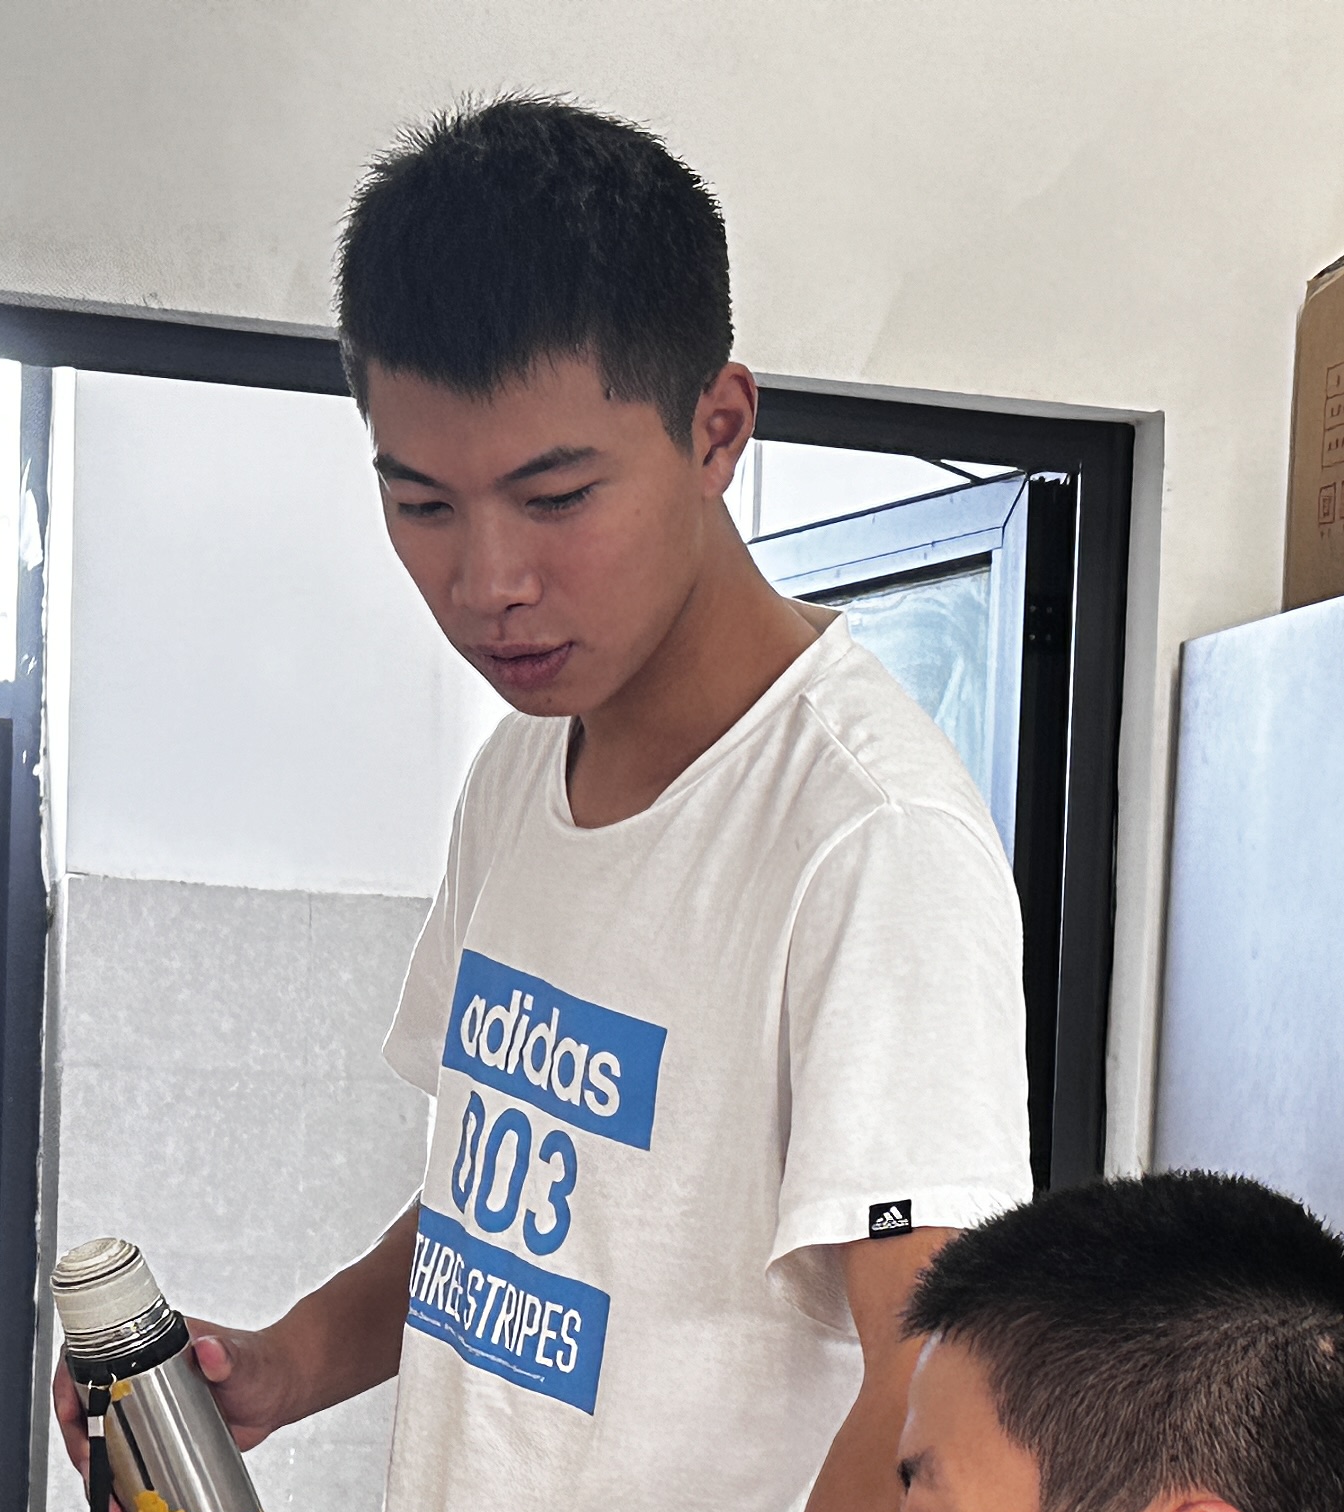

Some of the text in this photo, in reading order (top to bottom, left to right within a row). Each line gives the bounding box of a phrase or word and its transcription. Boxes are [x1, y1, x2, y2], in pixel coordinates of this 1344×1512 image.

[460, 989, 621, 1117] adidas
[452, 1090, 577, 1256] 003
[463, 1268, 582, 1373] STRIPES
